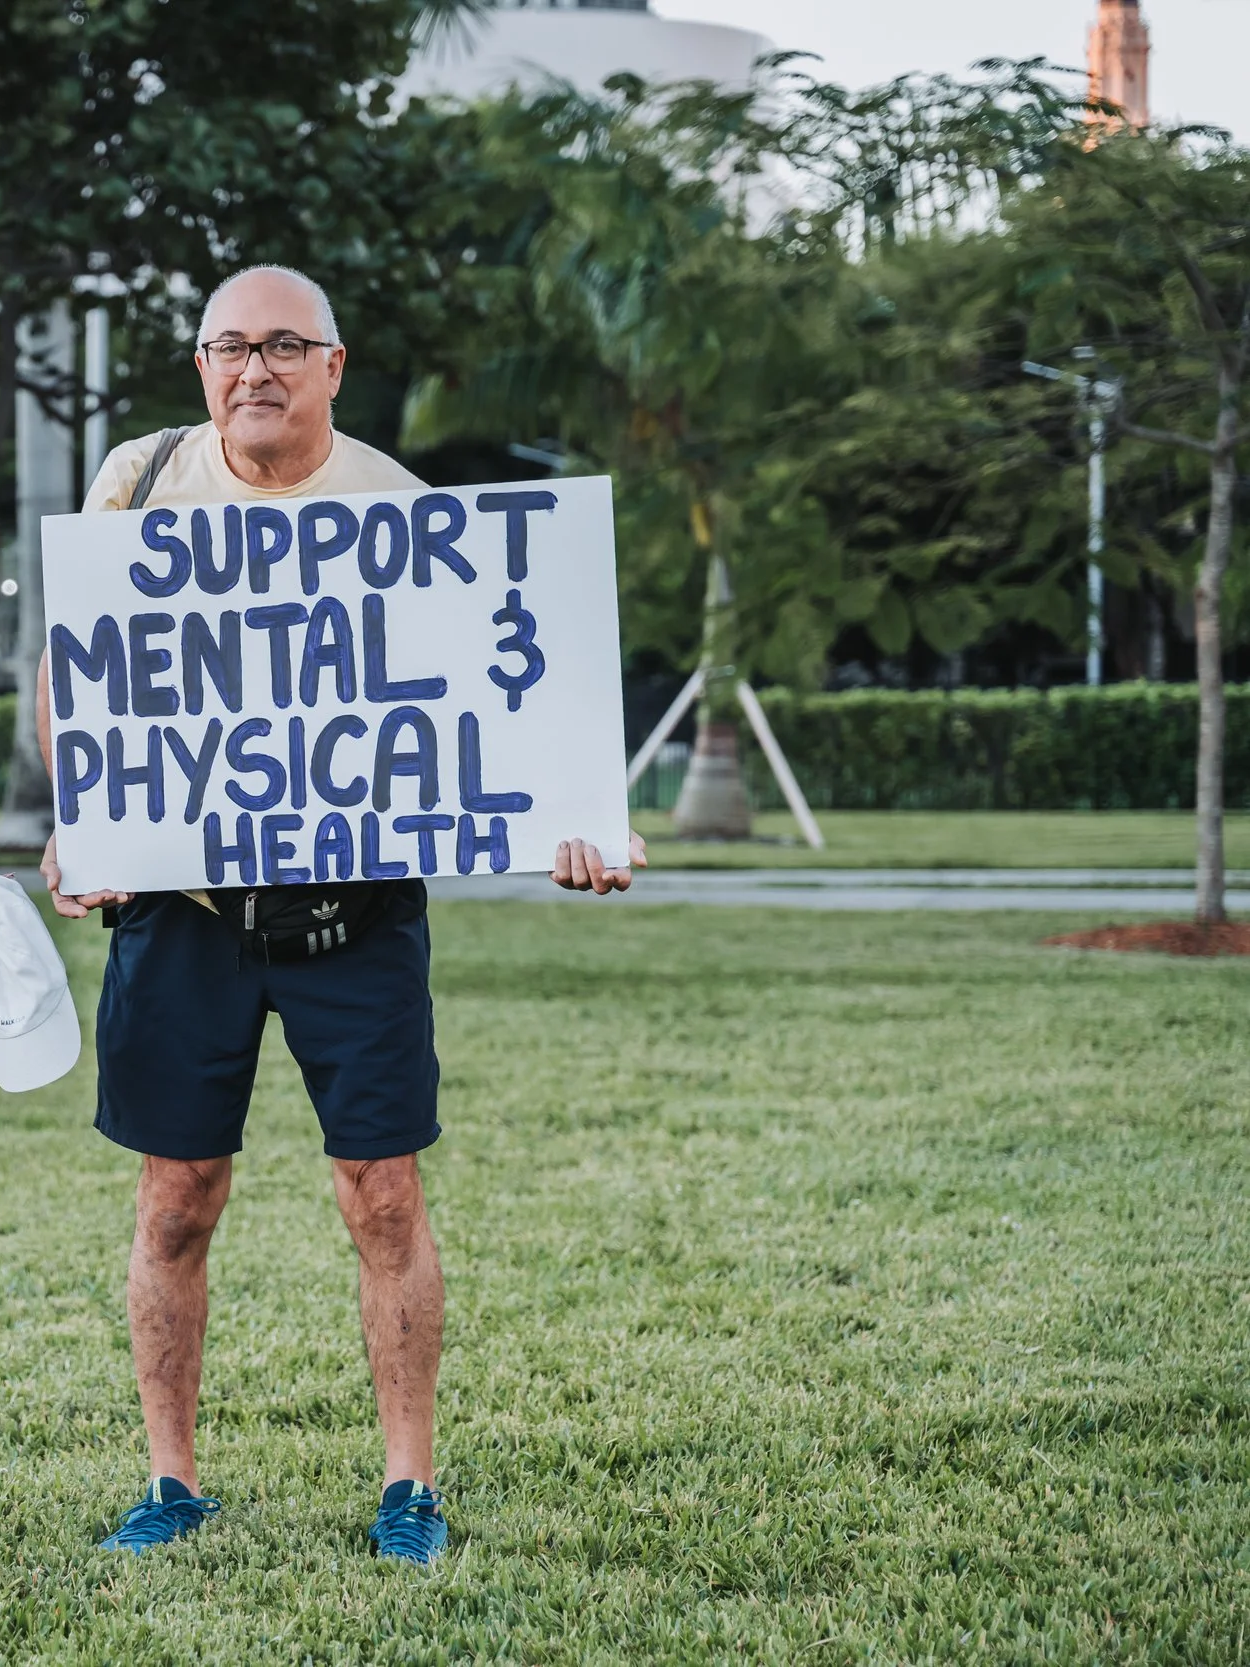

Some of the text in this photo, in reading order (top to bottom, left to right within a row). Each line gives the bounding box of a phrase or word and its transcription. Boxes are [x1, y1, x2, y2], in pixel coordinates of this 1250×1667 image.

[129, 491, 558, 598] SUPPORT
[51, 593, 448, 720] MENTAL
[57, 706, 534, 825] PHYSICAL
[203, 811, 511, 886] HEALTH
